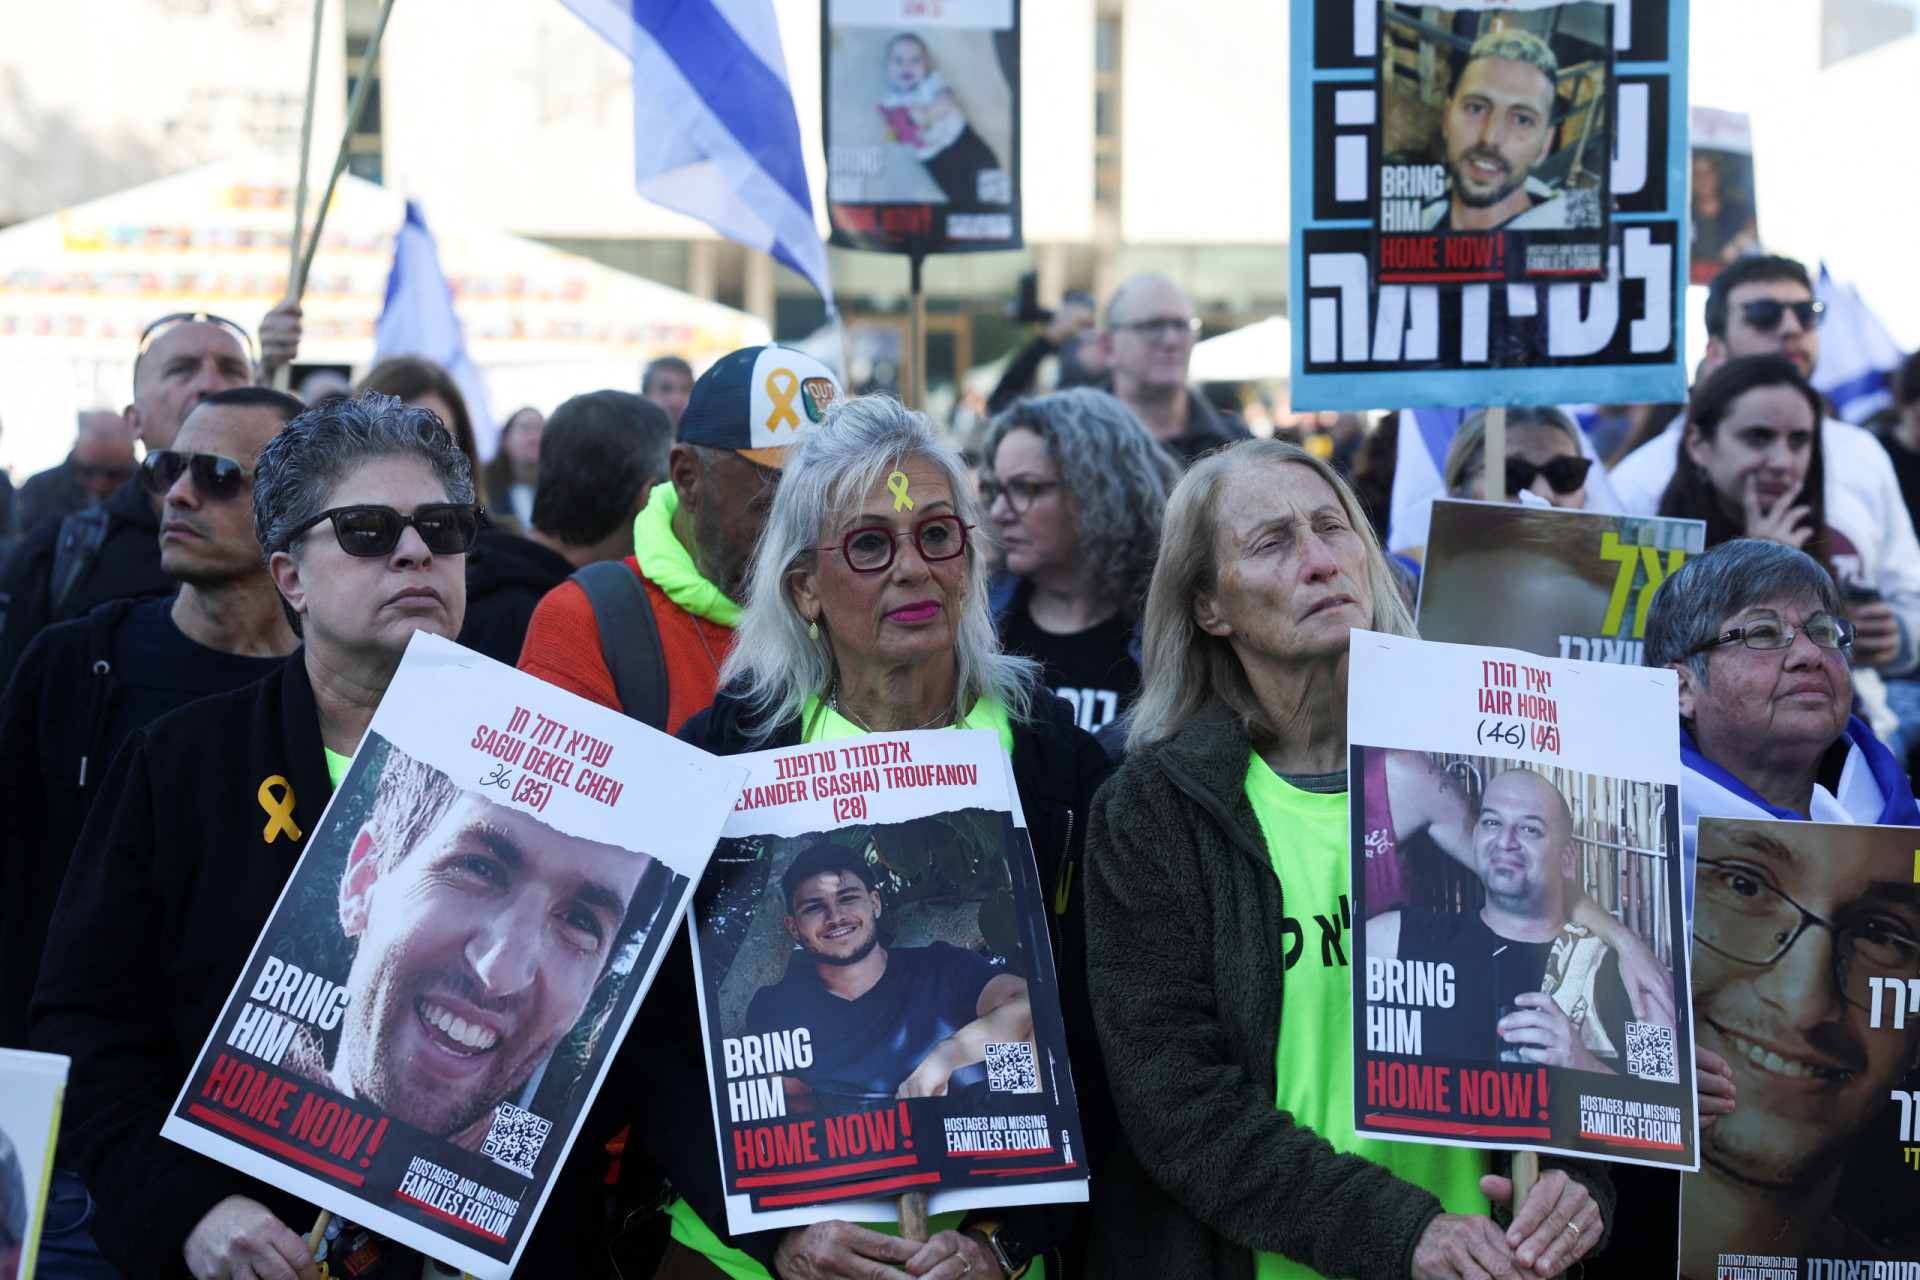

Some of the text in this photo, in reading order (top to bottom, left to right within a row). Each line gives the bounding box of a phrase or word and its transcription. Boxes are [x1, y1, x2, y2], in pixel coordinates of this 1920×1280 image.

[1381, 164, 1445, 198] BRING
[1381, 199, 1421, 231] HIM
[1381, 231, 1504, 268] HOME NOW!
[1482, 660, 1551, 694] יאיר הורן
[1479, 688, 1557, 724] IAIR HORN
[506, 706, 614, 768] שגיא דקל חן
[1477, 719, 1525, 749] (46)
[1531, 722, 1560, 755] (45)
[470, 725, 624, 807] SAGUI DEKEL CHEN
[774, 741, 912, 780] אלכסנדר טרופנוב
[511, 774, 553, 812] (35)
[733, 764, 978, 812] EXANDER (SASHA) TROUFANOV
[833, 795, 867, 823] (28)
[250, 955, 351, 1031] BRING
[1366, 955, 1455, 1008] BRING
[226, 1002, 298, 1066] HIM
[1367, 1006, 1422, 1055] HIM
[723, 1027, 813, 1078] BRING
[728, 1076, 786, 1122] HIM
[1367, 1060, 1550, 1120] HOME NOW!
[1580, 1094, 1680, 1122] HOSTAGES AND MISSING
[201, 1054, 391, 1169] HOME NOW!
[944, 1115, 1047, 1131] HOSTAGES AND MISSING
[1580, 1111, 1681, 1145] FAMILIES FORUM
[733, 1101, 913, 1170] HOME NOW!
[946, 1131, 1003, 1152] FAMILIES
[1005, 1129, 1050, 1150] FORUM
[399, 1171, 513, 1238] FAMILIES FORUM
[408, 1156, 520, 1216] HOSTAGES AND MISSING
